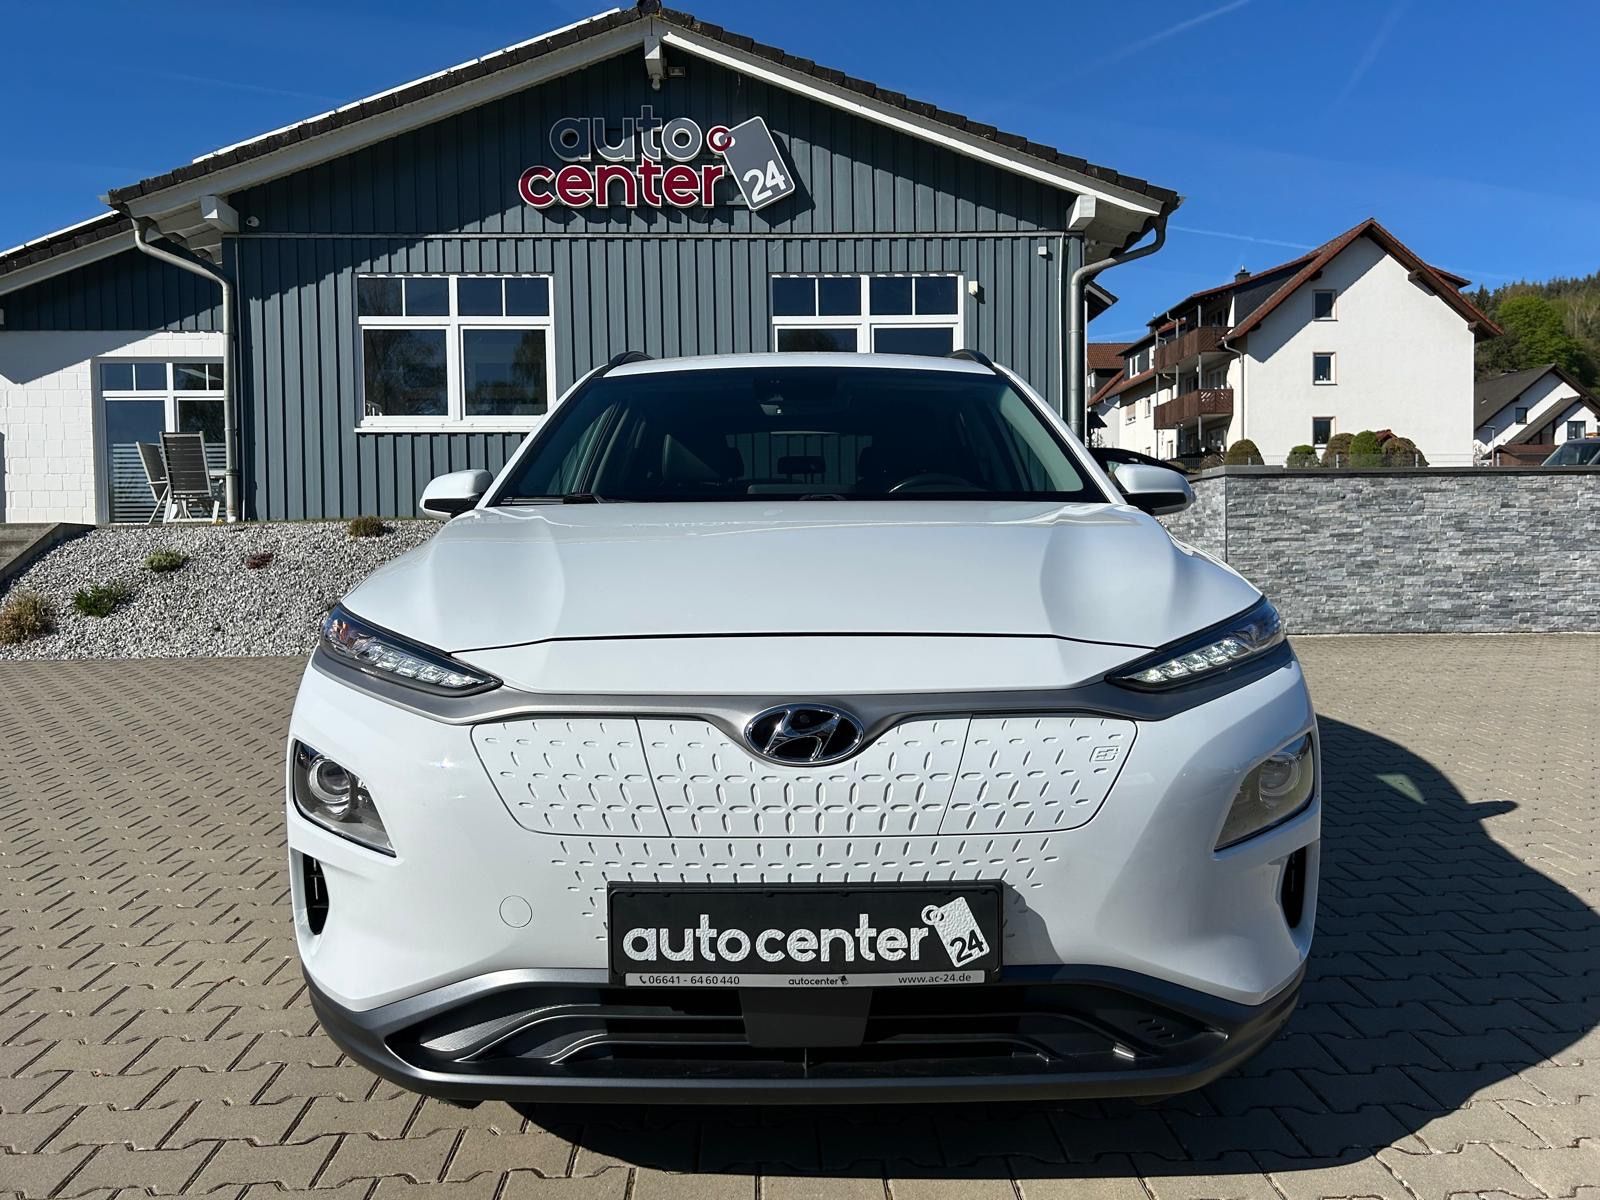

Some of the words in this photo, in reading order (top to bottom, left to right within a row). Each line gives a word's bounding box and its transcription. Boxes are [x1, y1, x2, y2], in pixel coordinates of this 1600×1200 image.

[549, 104, 703, 162] auto
[518, 158, 726, 208] center
[742, 159, 786, 203] 24
[949, 929, 985, 963] 24
[648, 975, 681, 985] 06641
[788, 976, 839, 986] autocenter
[898, 973, 972, 984] www.ac-24.de
